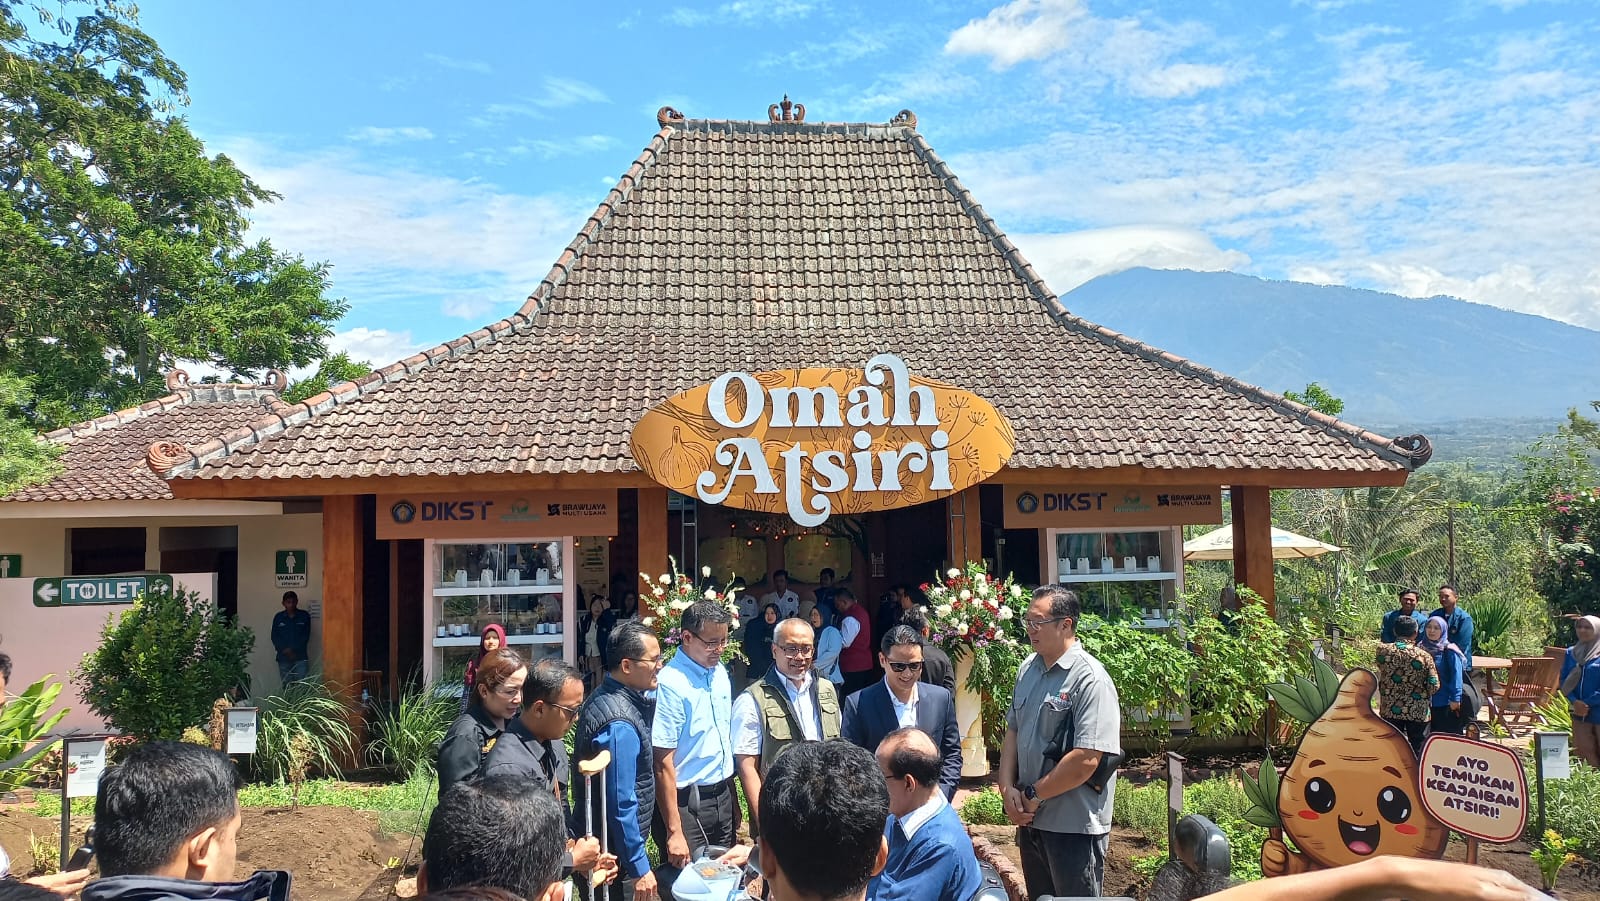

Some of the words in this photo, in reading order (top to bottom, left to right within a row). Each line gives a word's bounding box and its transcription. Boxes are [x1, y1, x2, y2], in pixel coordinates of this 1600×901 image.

[707, 354, 940, 428] Omah
[696, 430, 954, 527] Atsiri
[422, 501, 494, 521] DIKST
[562, 503, 606, 511] BRAWIJAYA
[1043, 492, 1108, 512] DIKST
[66, 581, 141, 600] TOILET
[1456, 755, 1489, 772] AYO
[1431, 764, 1515, 793] TEMUKAN
[1426, 778, 1520, 809] KEAJAIBAN
[1443, 796, 1500, 819] ATSIRI!
